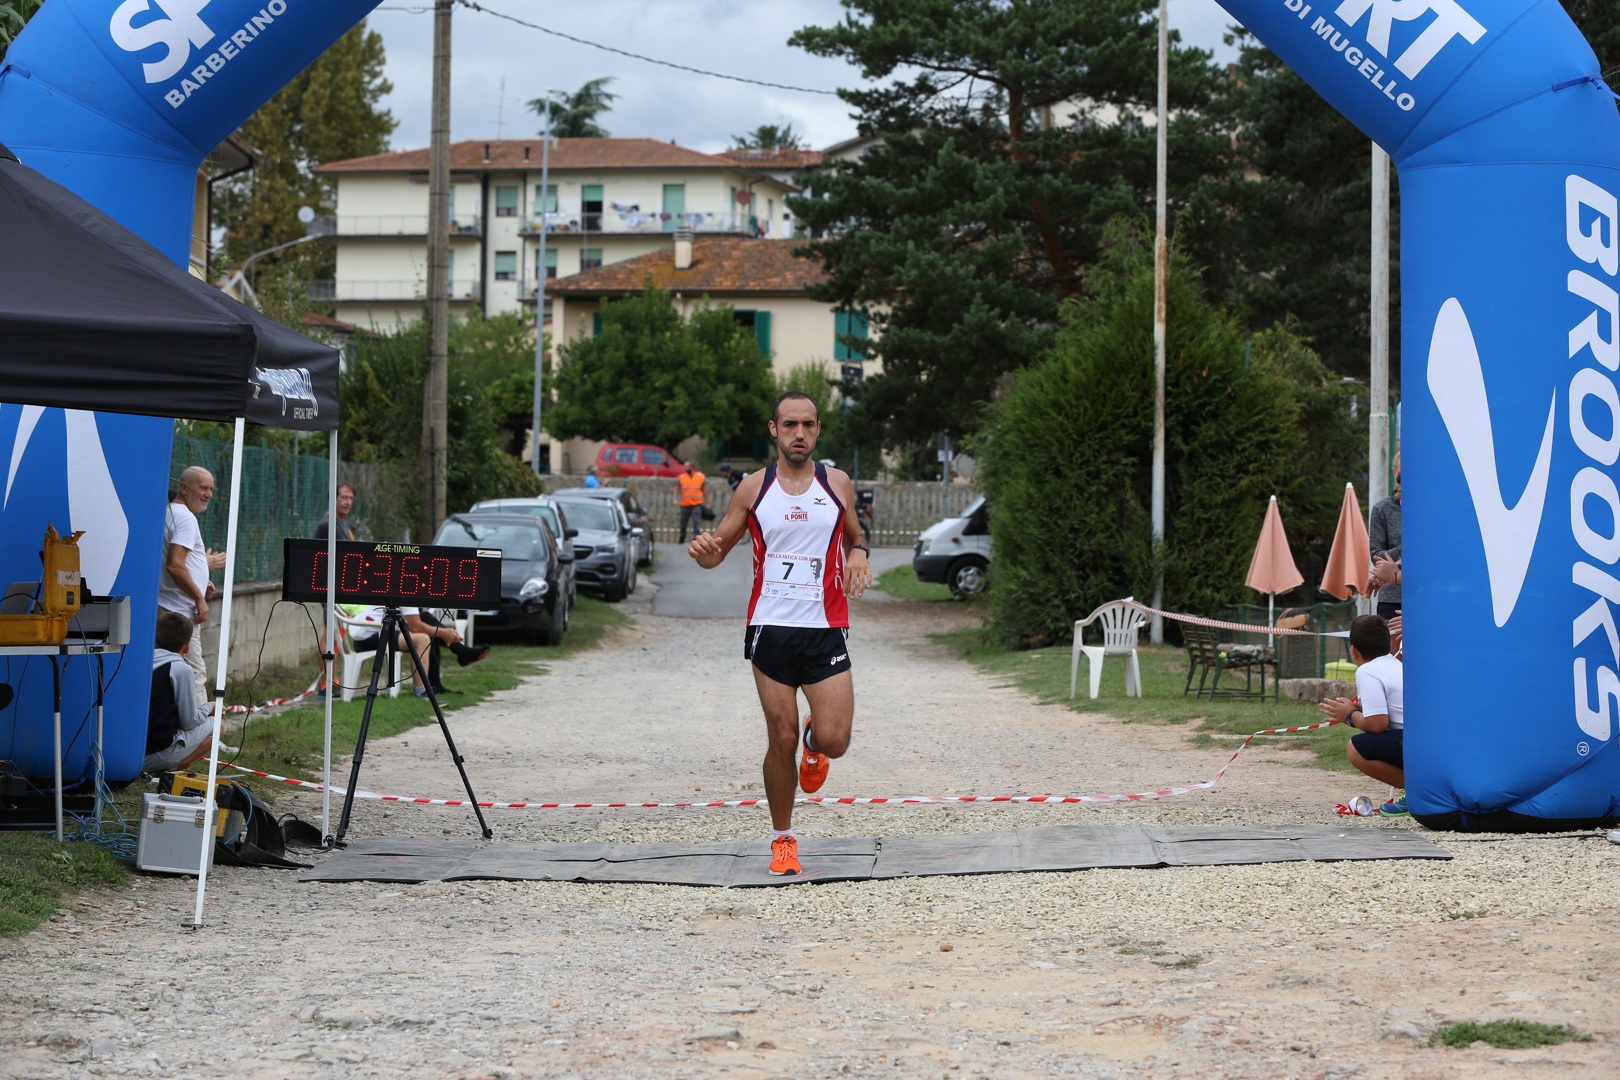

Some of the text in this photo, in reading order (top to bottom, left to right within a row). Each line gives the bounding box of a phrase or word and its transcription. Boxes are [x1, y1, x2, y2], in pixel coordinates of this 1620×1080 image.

[163, 0, 287, 109] BARBERINO
[1284, 0, 1415, 111] DI MUGELLO
[1565, 174, 1620, 743] BROOKS
[782, 562, 794, 580] 7
